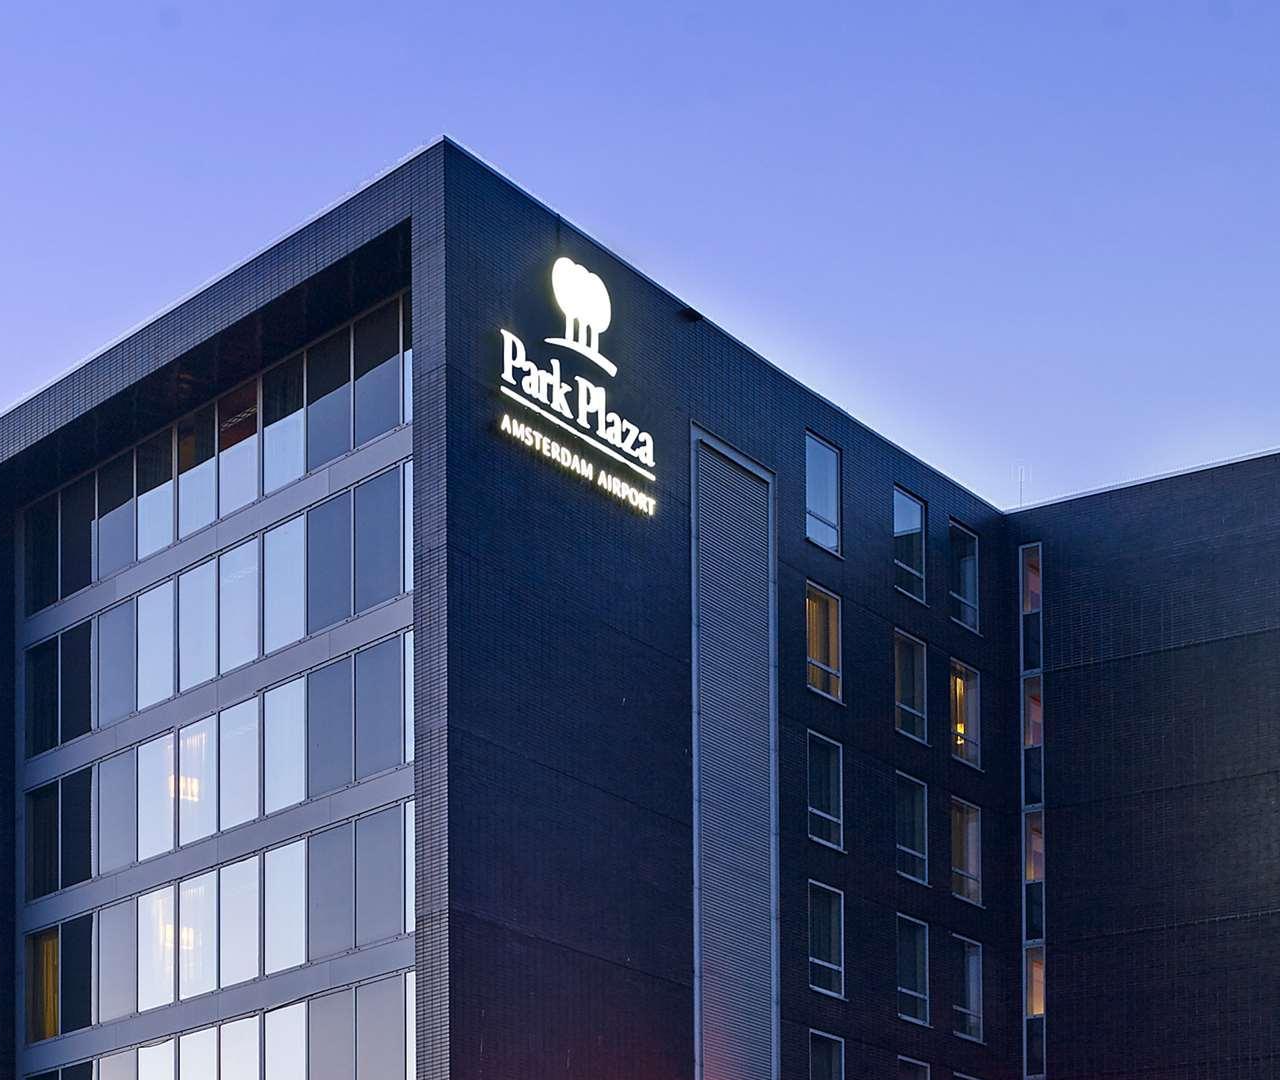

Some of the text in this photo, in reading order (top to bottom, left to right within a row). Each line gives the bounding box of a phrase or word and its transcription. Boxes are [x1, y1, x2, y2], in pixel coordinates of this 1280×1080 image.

[500, 328, 656, 467] Park Plaza
[500, 414, 656, 516] AMSTERDAM AIRPORT
